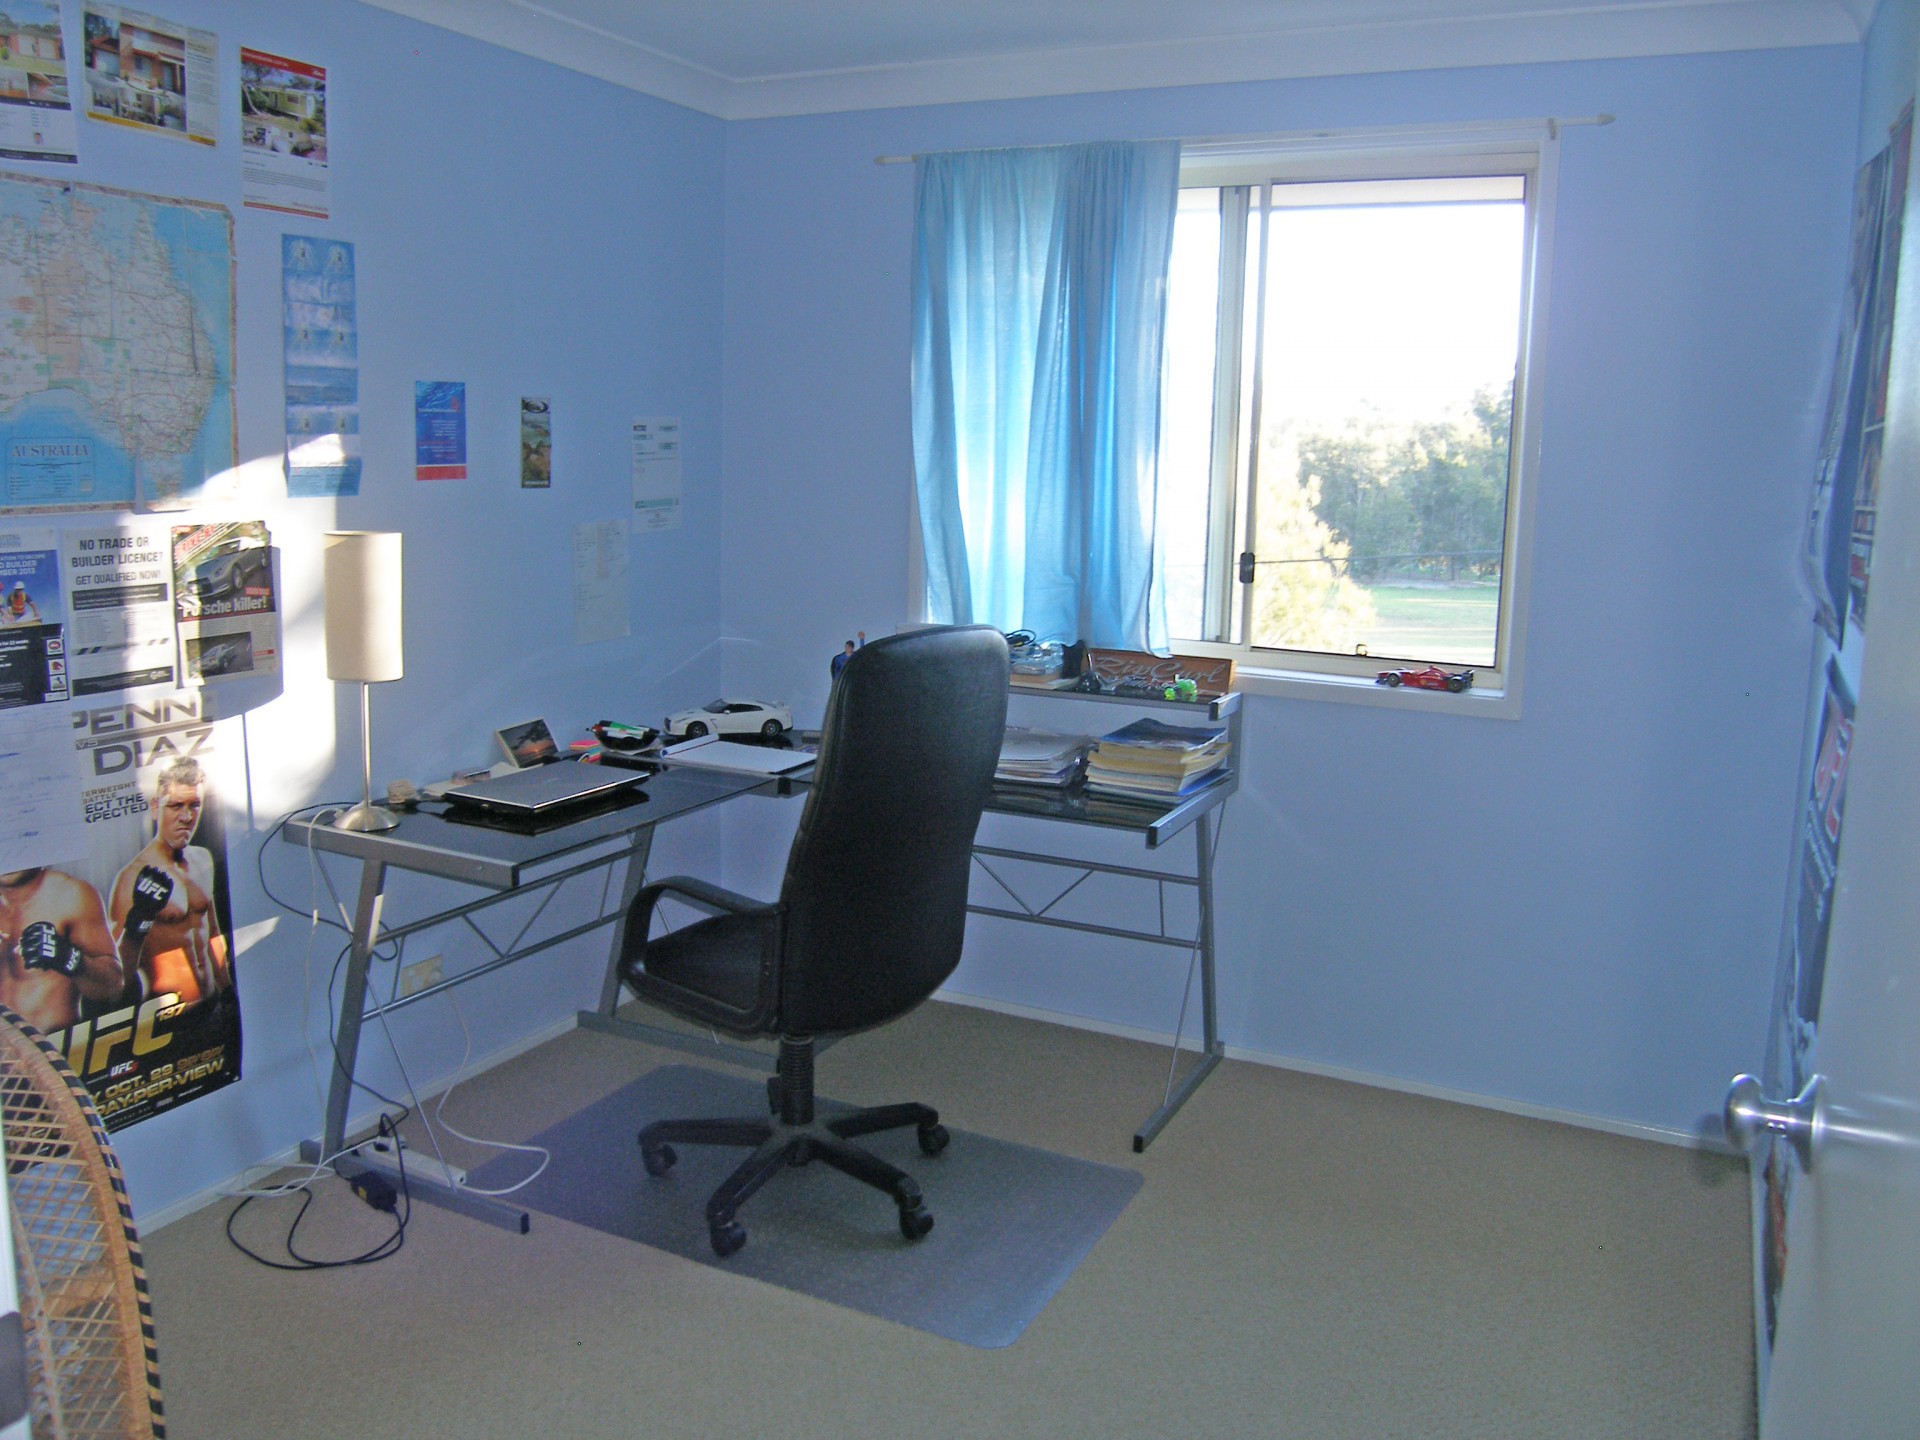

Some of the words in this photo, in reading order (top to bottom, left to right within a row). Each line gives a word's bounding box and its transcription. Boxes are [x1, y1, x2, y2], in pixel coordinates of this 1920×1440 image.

[12, 445, 89, 457] AUSTRALIA
[80, 539, 95, 551] NO
[98, 538, 133, 549] TRADE
[136, 536, 149, 547] OR
[6, 560, 37, 569] BUILDER
[71, 555, 114, 567] BUILDER
[117, 552, 164, 564] LICENCE?
[75, 575, 92, 585] GET
[94, 571, 136, 583] QUALIFIED
[138, 569, 161, 580] NOW!
[182, 599, 232, 617] Porsche
[233, 596, 268, 612] killer!
[94, 726, 214, 777] DIAZ
[82, 792, 117, 805] BATTLE
[115, 792, 144, 806] THE
[137, 877, 168, 901] UFC
[42, 924, 56, 958] UFC
[45, 992, 180, 1078] UFC
[95, 1058, 224, 1116] PAY-PER-VIEW
[105, 1075, 145, 1099] OCT.
[150, 1063, 174, 1081] 29
